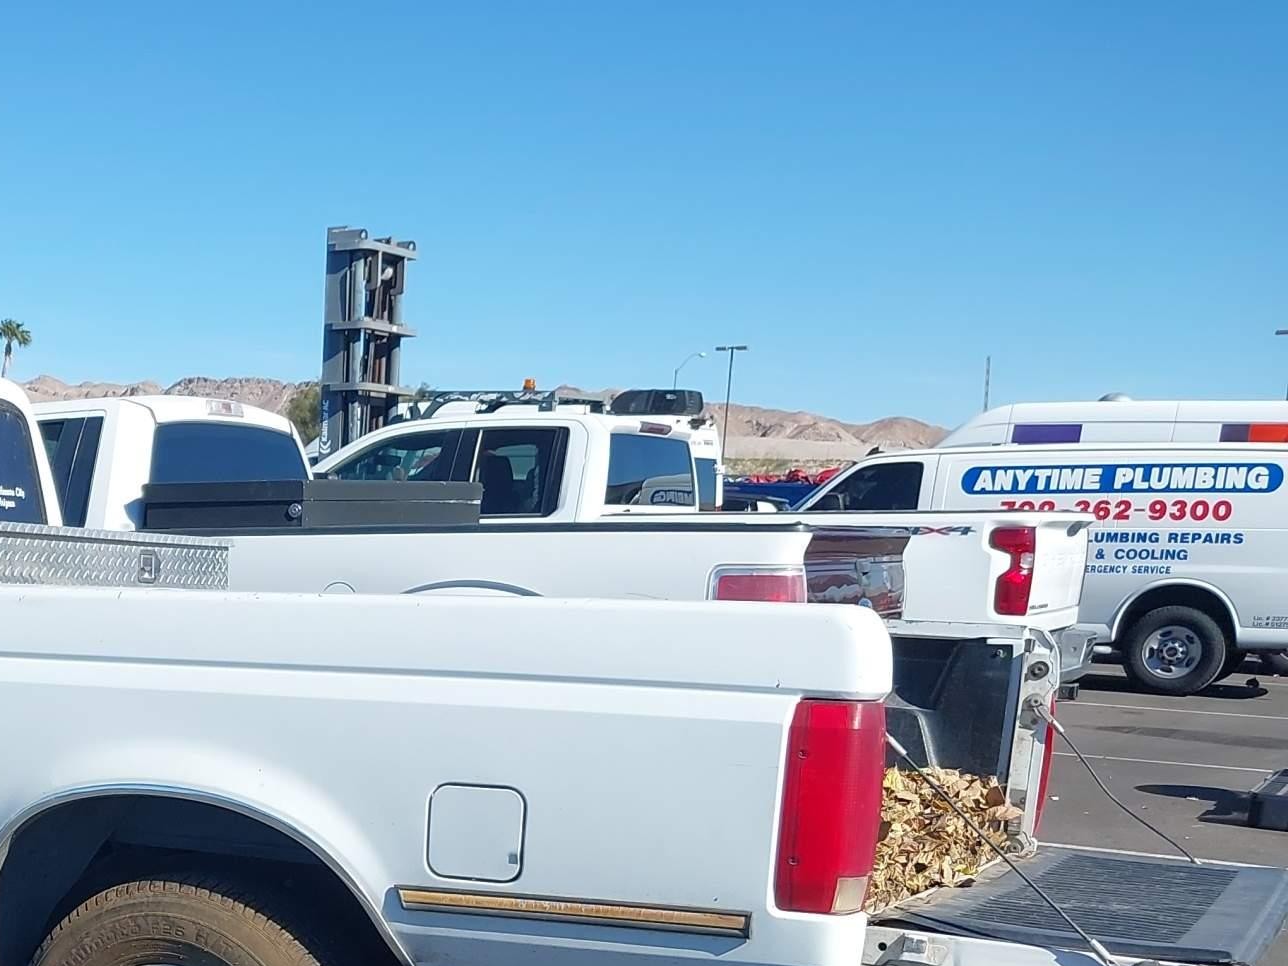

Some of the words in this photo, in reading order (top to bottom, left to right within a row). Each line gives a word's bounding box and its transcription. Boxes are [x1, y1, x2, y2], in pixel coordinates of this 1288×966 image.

[973, 466, 1103, 492] ANYTIME
[1113, 464, 1271, 491] PLUMBING
[1000, 499, 1232, 521] 362-9300
[1088, 532, 1160, 544] UMBING
[1168, 532, 1245, 545] REPAIRS
[1095, 548, 1106, 560] &
[1114, 548, 1190, 561] COOLING
[1131, 565, 1172, 575] SERVICE
